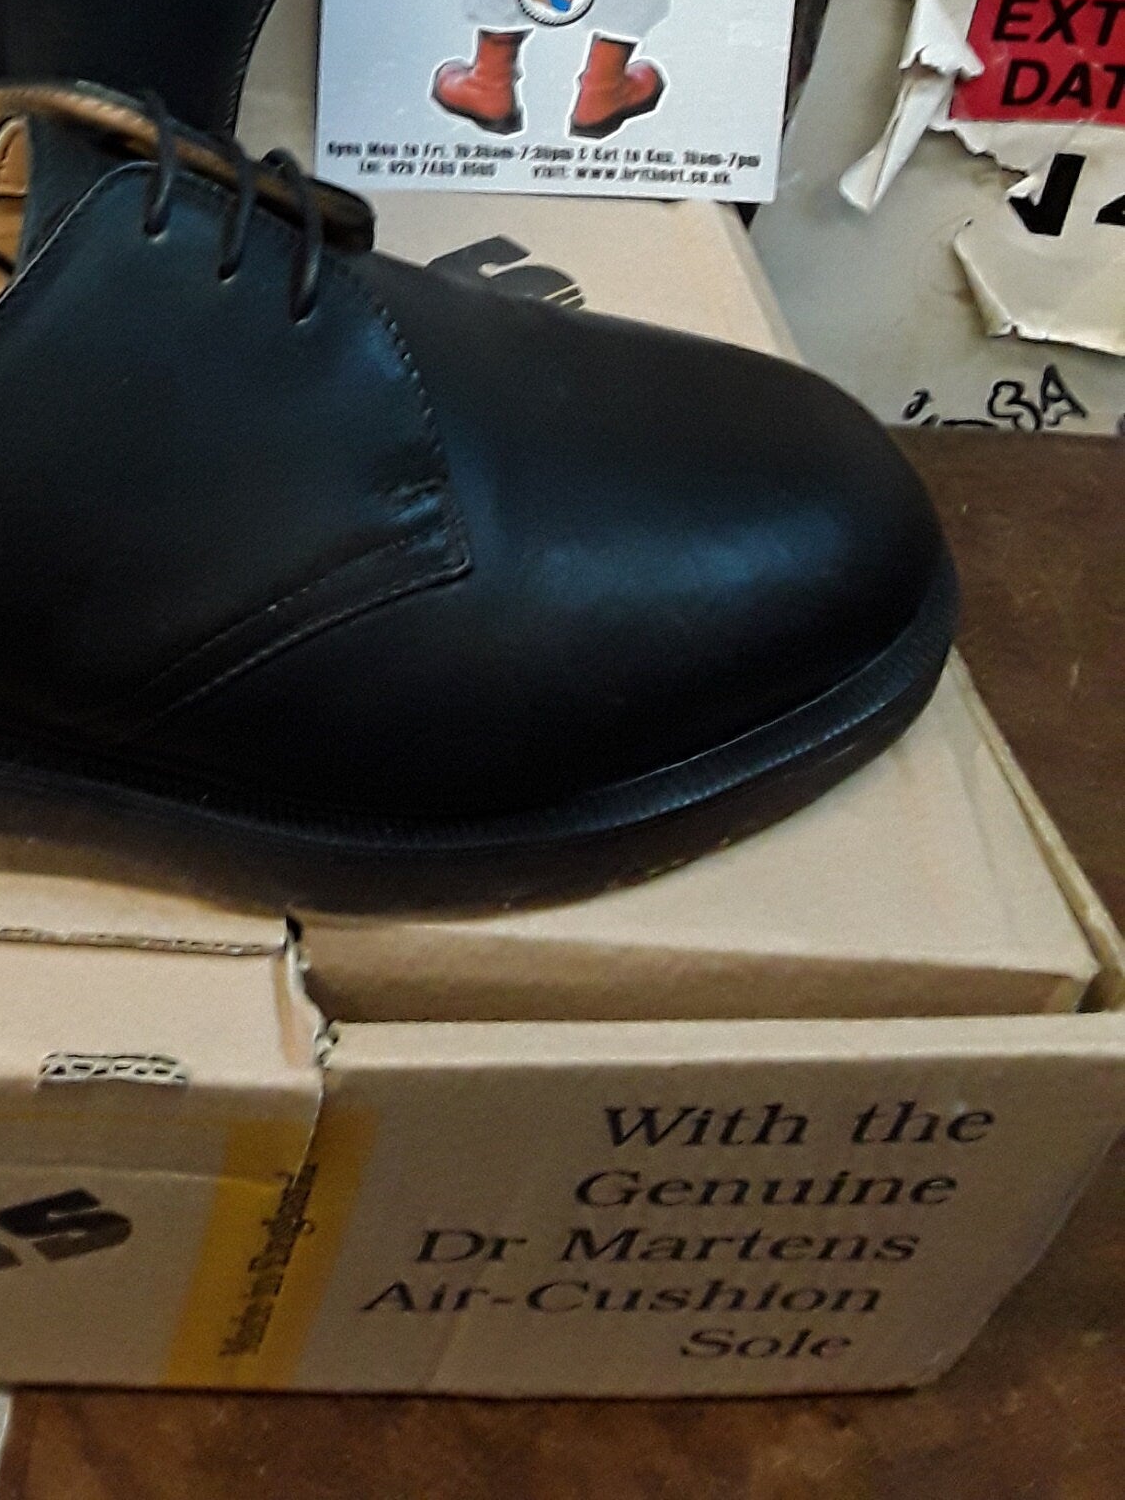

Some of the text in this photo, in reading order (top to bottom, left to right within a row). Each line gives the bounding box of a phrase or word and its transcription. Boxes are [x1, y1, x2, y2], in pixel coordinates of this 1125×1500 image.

[600, 1101, 996, 1148] With the
[575, 1168, 958, 1207] Genuine
[415, 1227, 921, 1264] Dr Martens
[361, 1278, 883, 1313] Air-Cushion
[679, 1327, 854, 1361] Sole
